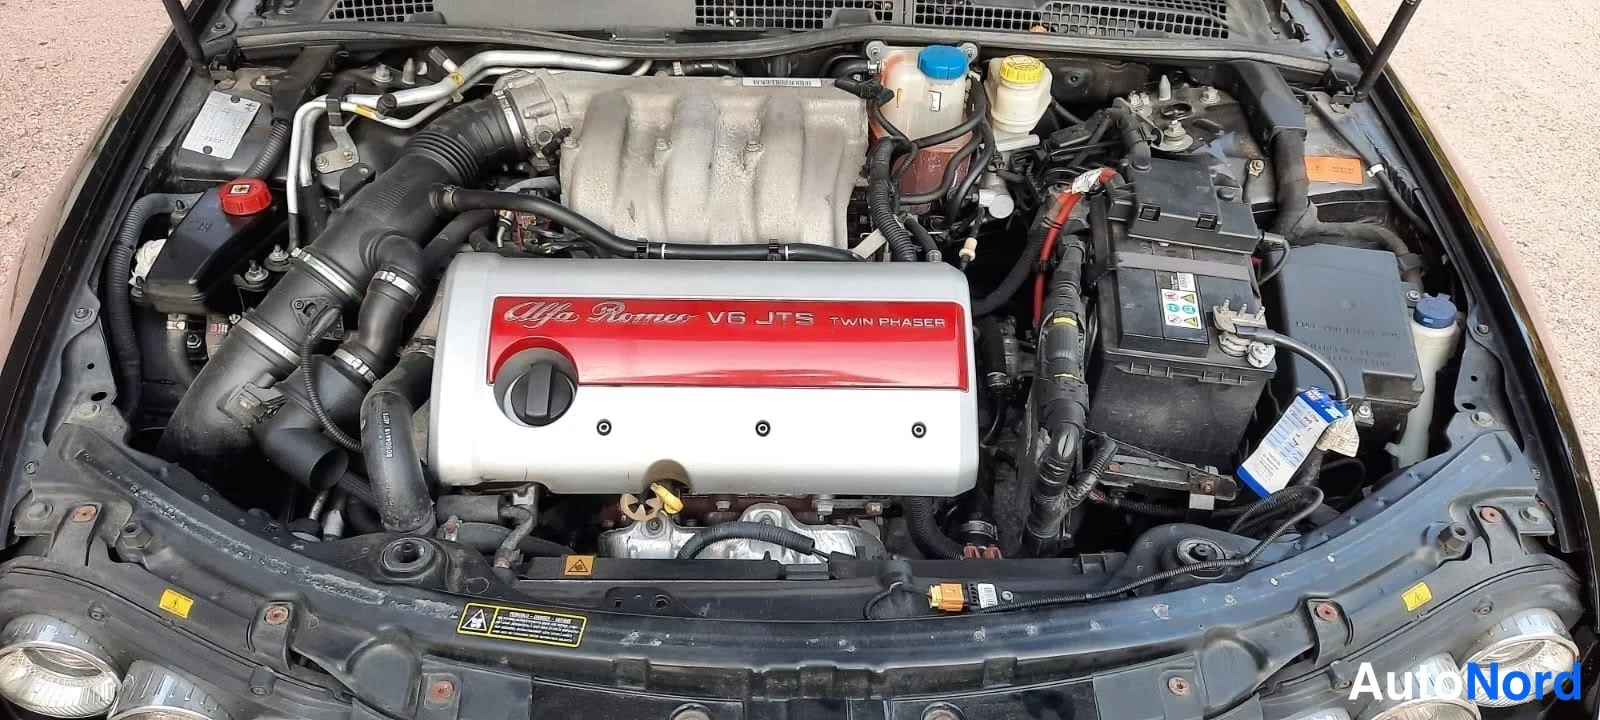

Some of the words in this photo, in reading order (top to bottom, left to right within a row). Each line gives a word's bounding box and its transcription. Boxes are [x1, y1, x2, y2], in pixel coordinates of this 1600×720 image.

[504, 301, 580, 328] Alfa
[586, 301, 699, 324] Romeo
[707, 311, 746, 325] V6
[755, 311, 815, 326] JTS
[830, 317, 873, 327] TWIN
[879, 317, 946, 328] PHASER
